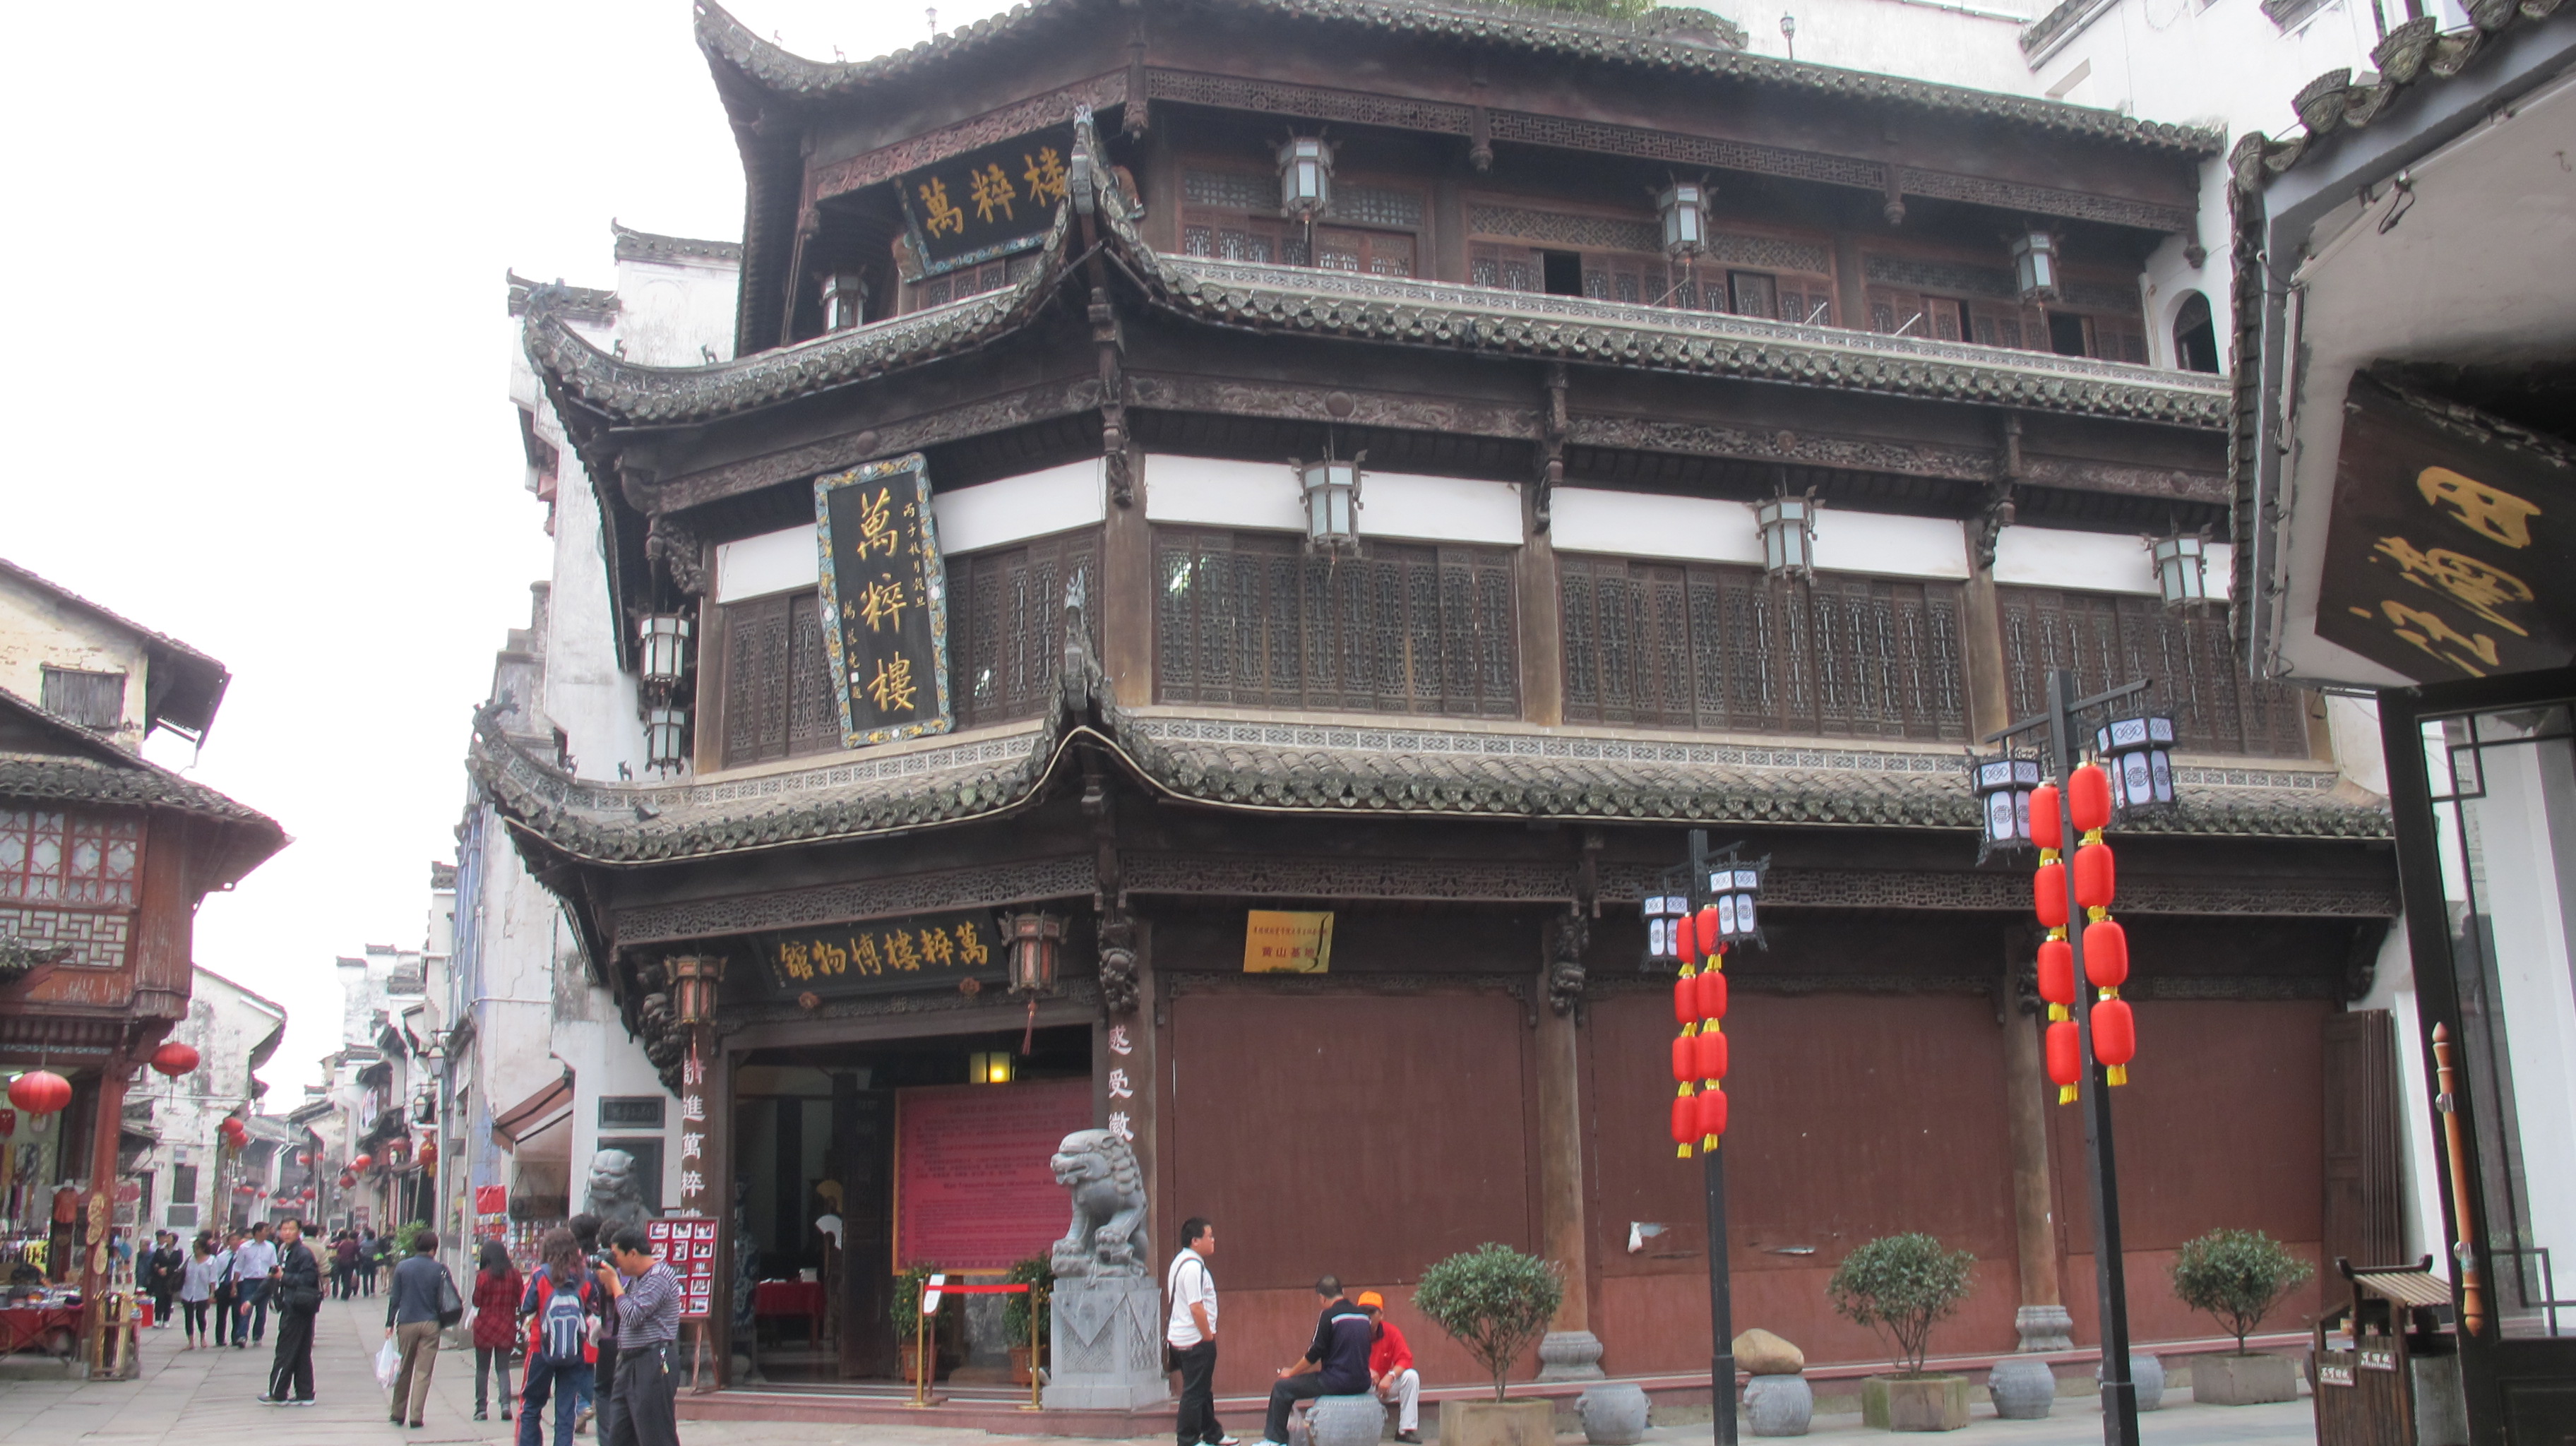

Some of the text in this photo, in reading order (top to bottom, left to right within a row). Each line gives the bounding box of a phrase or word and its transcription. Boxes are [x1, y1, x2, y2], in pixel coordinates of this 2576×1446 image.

[857, 487, 917, 712] 萬粹樓
[681, 1059, 706, 1218] 請進萬粹
